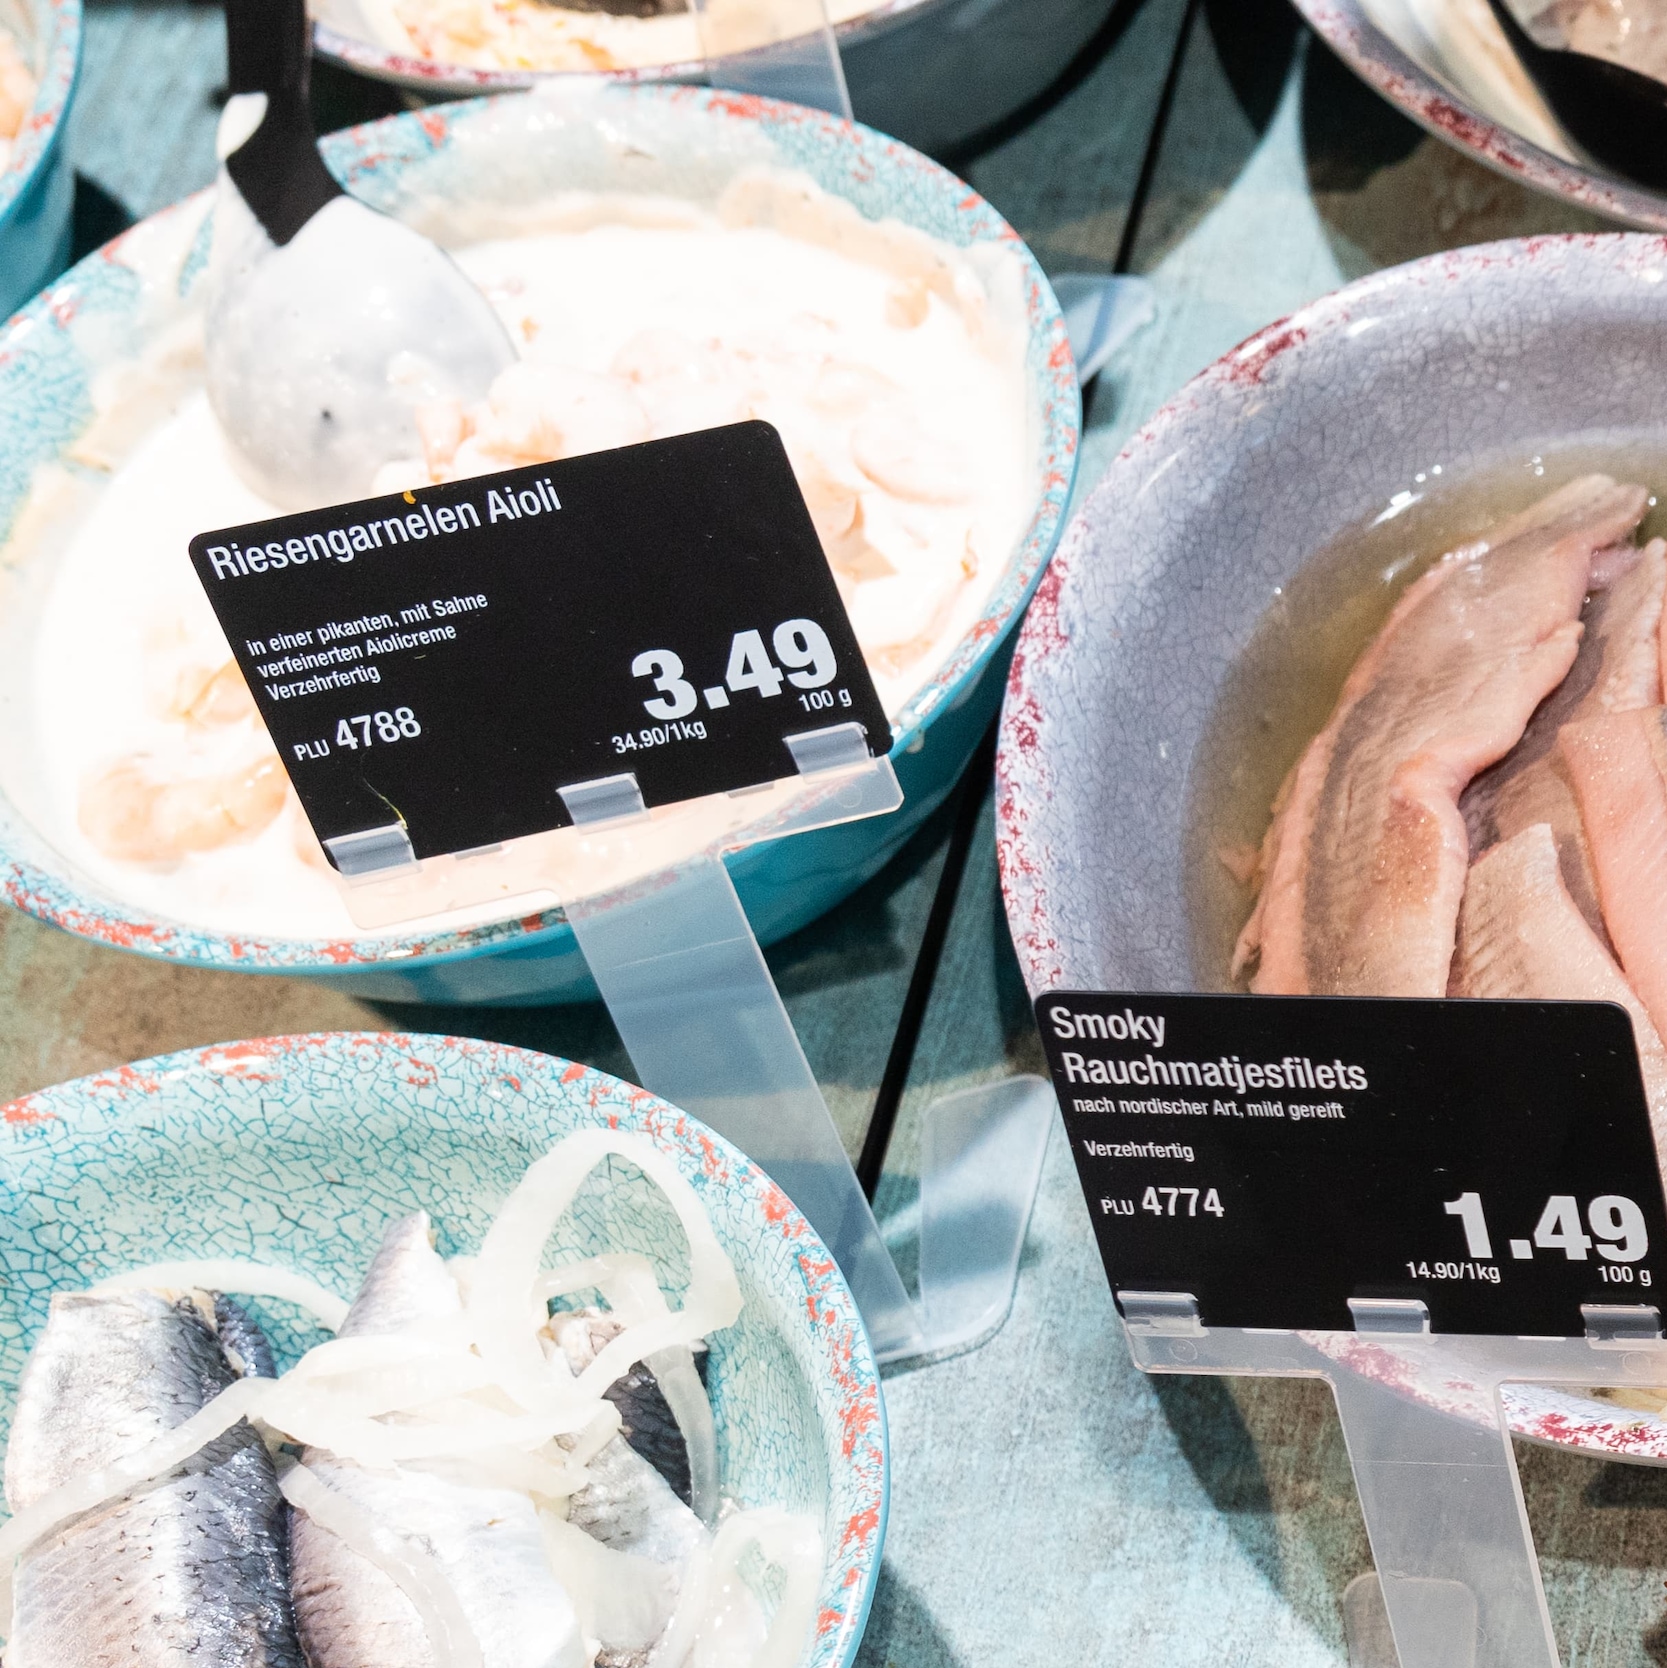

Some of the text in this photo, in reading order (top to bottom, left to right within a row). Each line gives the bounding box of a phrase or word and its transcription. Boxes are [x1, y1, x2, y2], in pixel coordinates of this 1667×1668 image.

[206, 477, 562, 580] Riesengarnelen Aioli
[245, 594, 488, 657] in einer pikanten, mit Sahne
[256, 625, 457, 678] verfeinerten Aiolicreme
[631, 618, 838, 721] 3.49
[264, 664, 382, 701] Verzehrfertig
[798, 688, 853, 712] 100 g
[293, 706, 422, 761] PLU 4788
[611, 720, 708, 754] 34.90/1kg
[1049, 1006, 1165, 1048] Smoky
[1061, 1051, 1369, 1095] Rauchmatjesfilets
[1072, 1096, 1346, 1121] nach nordischer Art, mild gereift
[1083, 1139, 1195, 1163] Verzehrfertig
[1100, 1186, 1225, 1218] PLU 4774
[1443, 1191, 1649, 1263] 1.49
[1406, 1261, 1501, 1284] 14.90/1kg
[1597, 1265, 1652, 1287] 100 g
